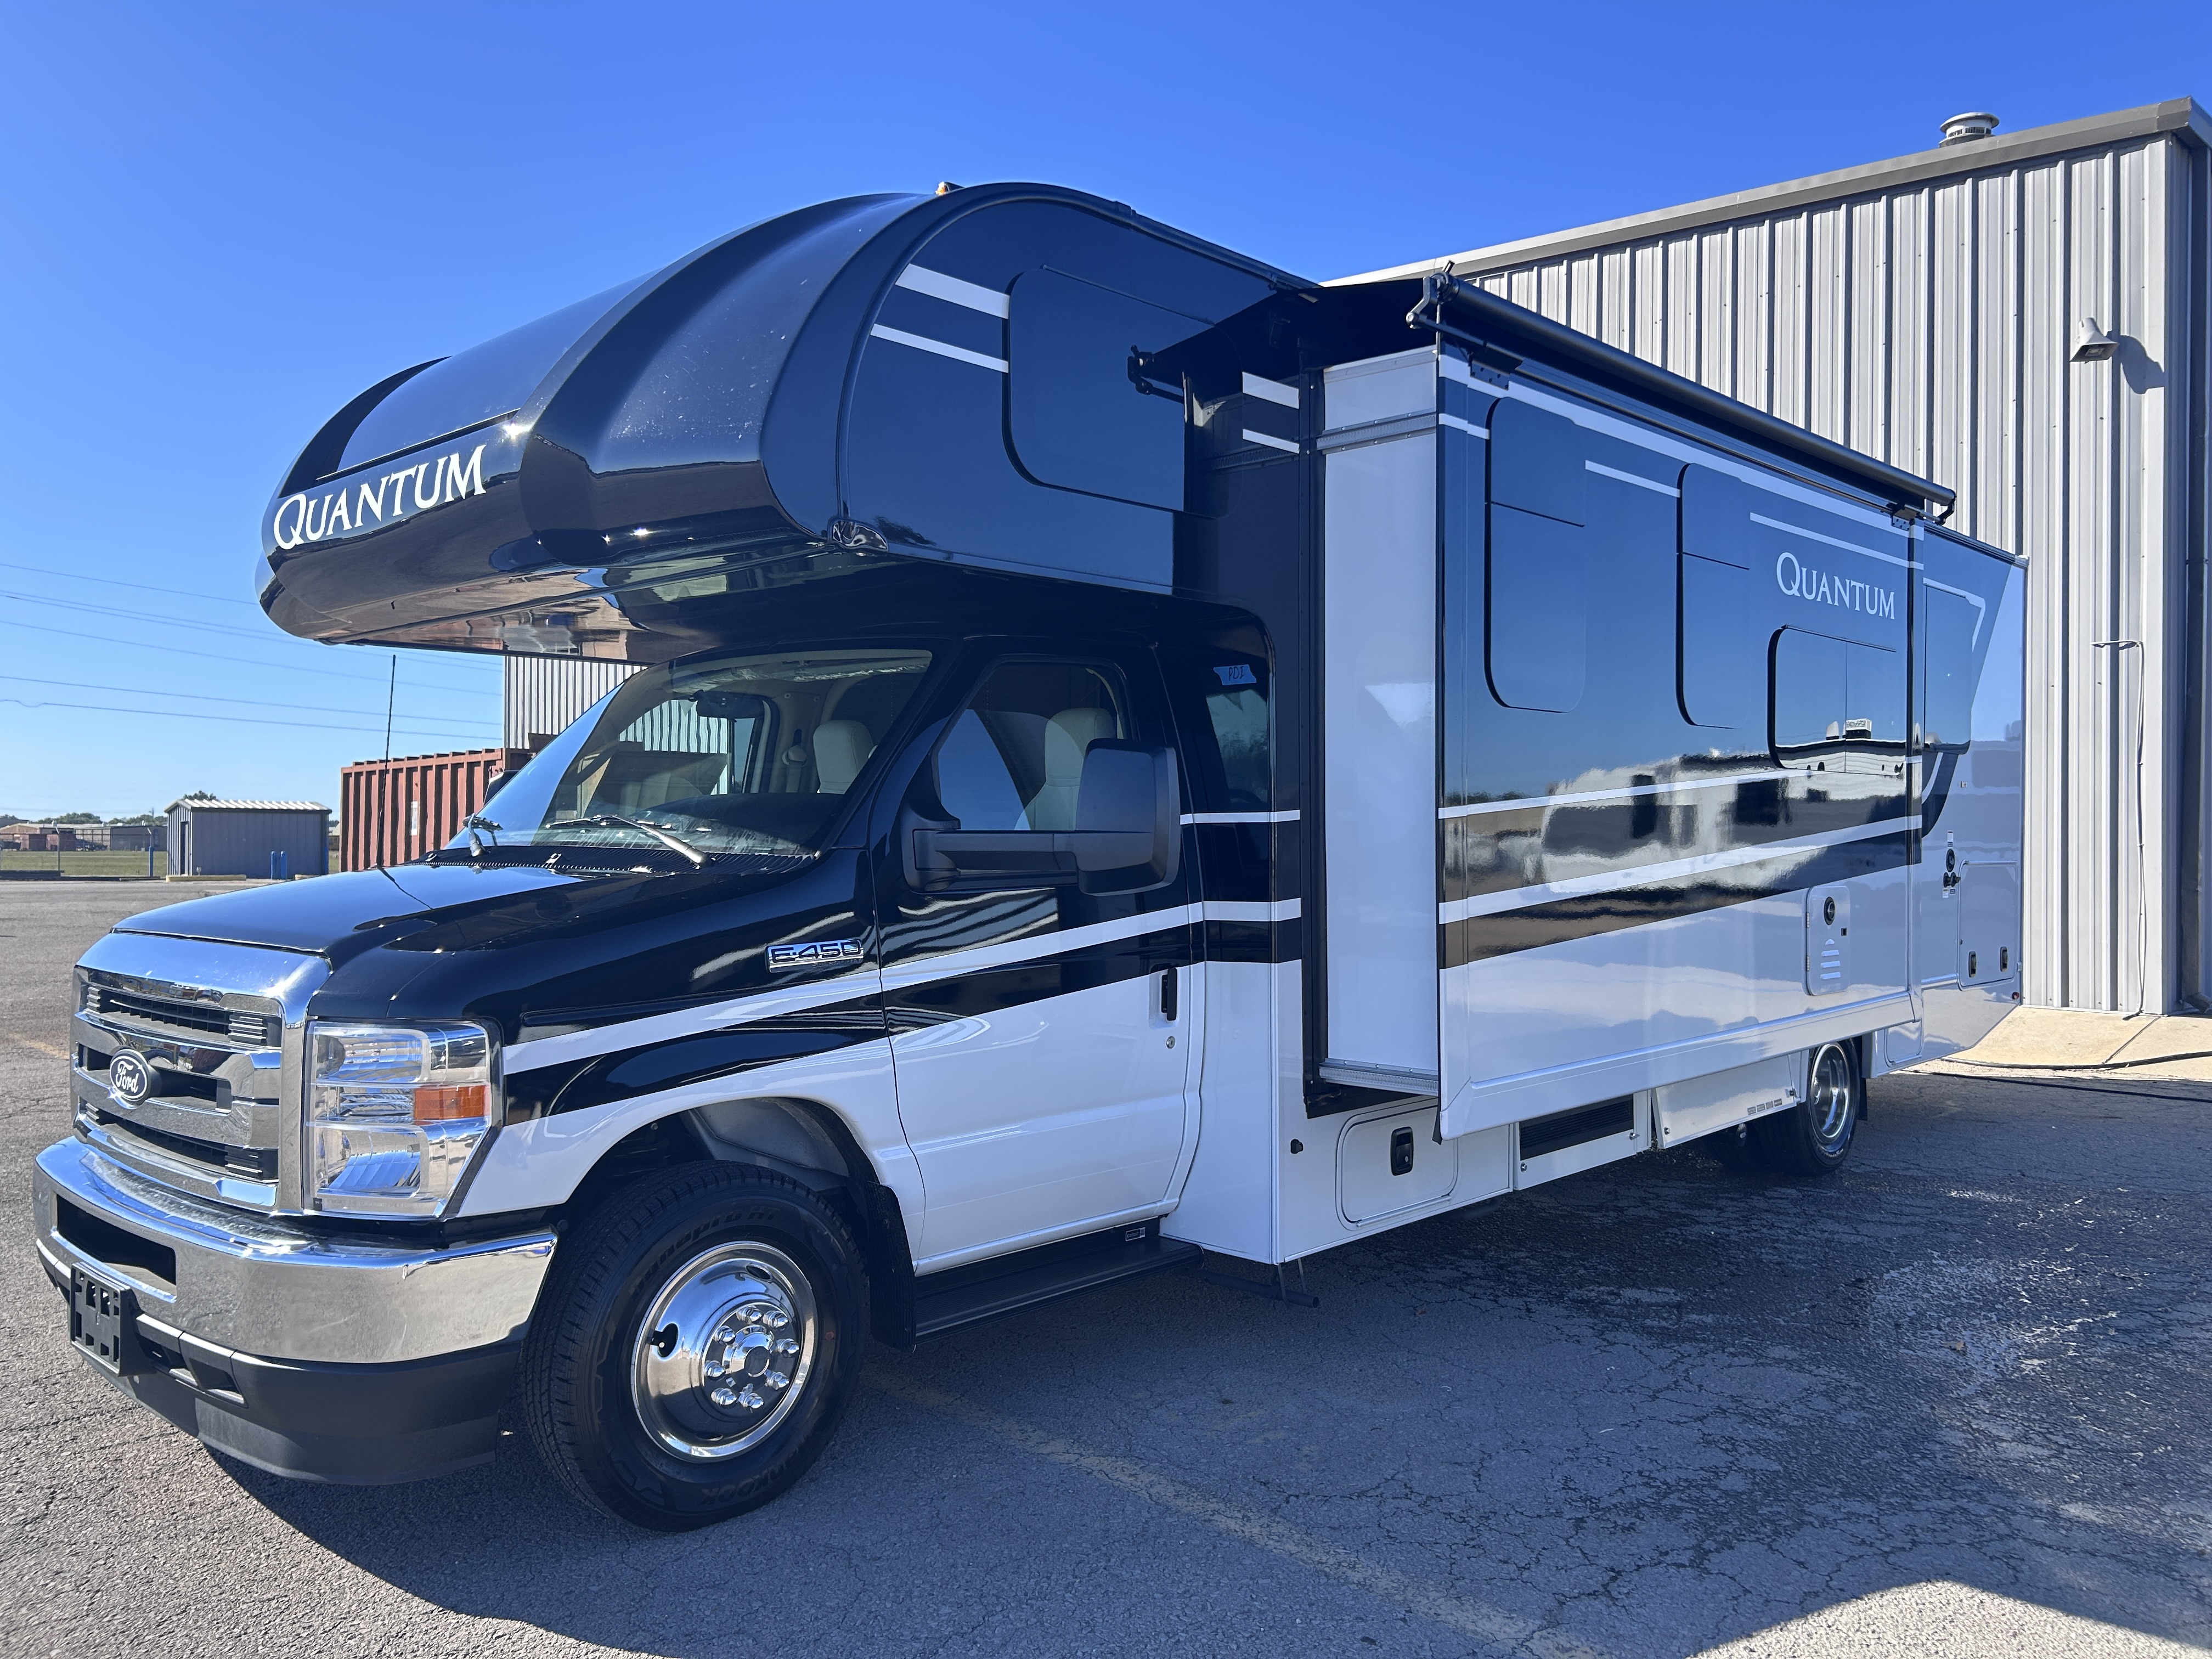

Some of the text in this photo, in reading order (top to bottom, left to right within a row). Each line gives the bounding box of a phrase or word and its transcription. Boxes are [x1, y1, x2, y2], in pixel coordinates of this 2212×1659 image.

[274, 444, 487, 550] QUANTUM
[1776, 552, 1895, 619] QUANTUM
[1228, 665, 1245, 681] PDI
[116, 1060, 139, 1093] Ford
